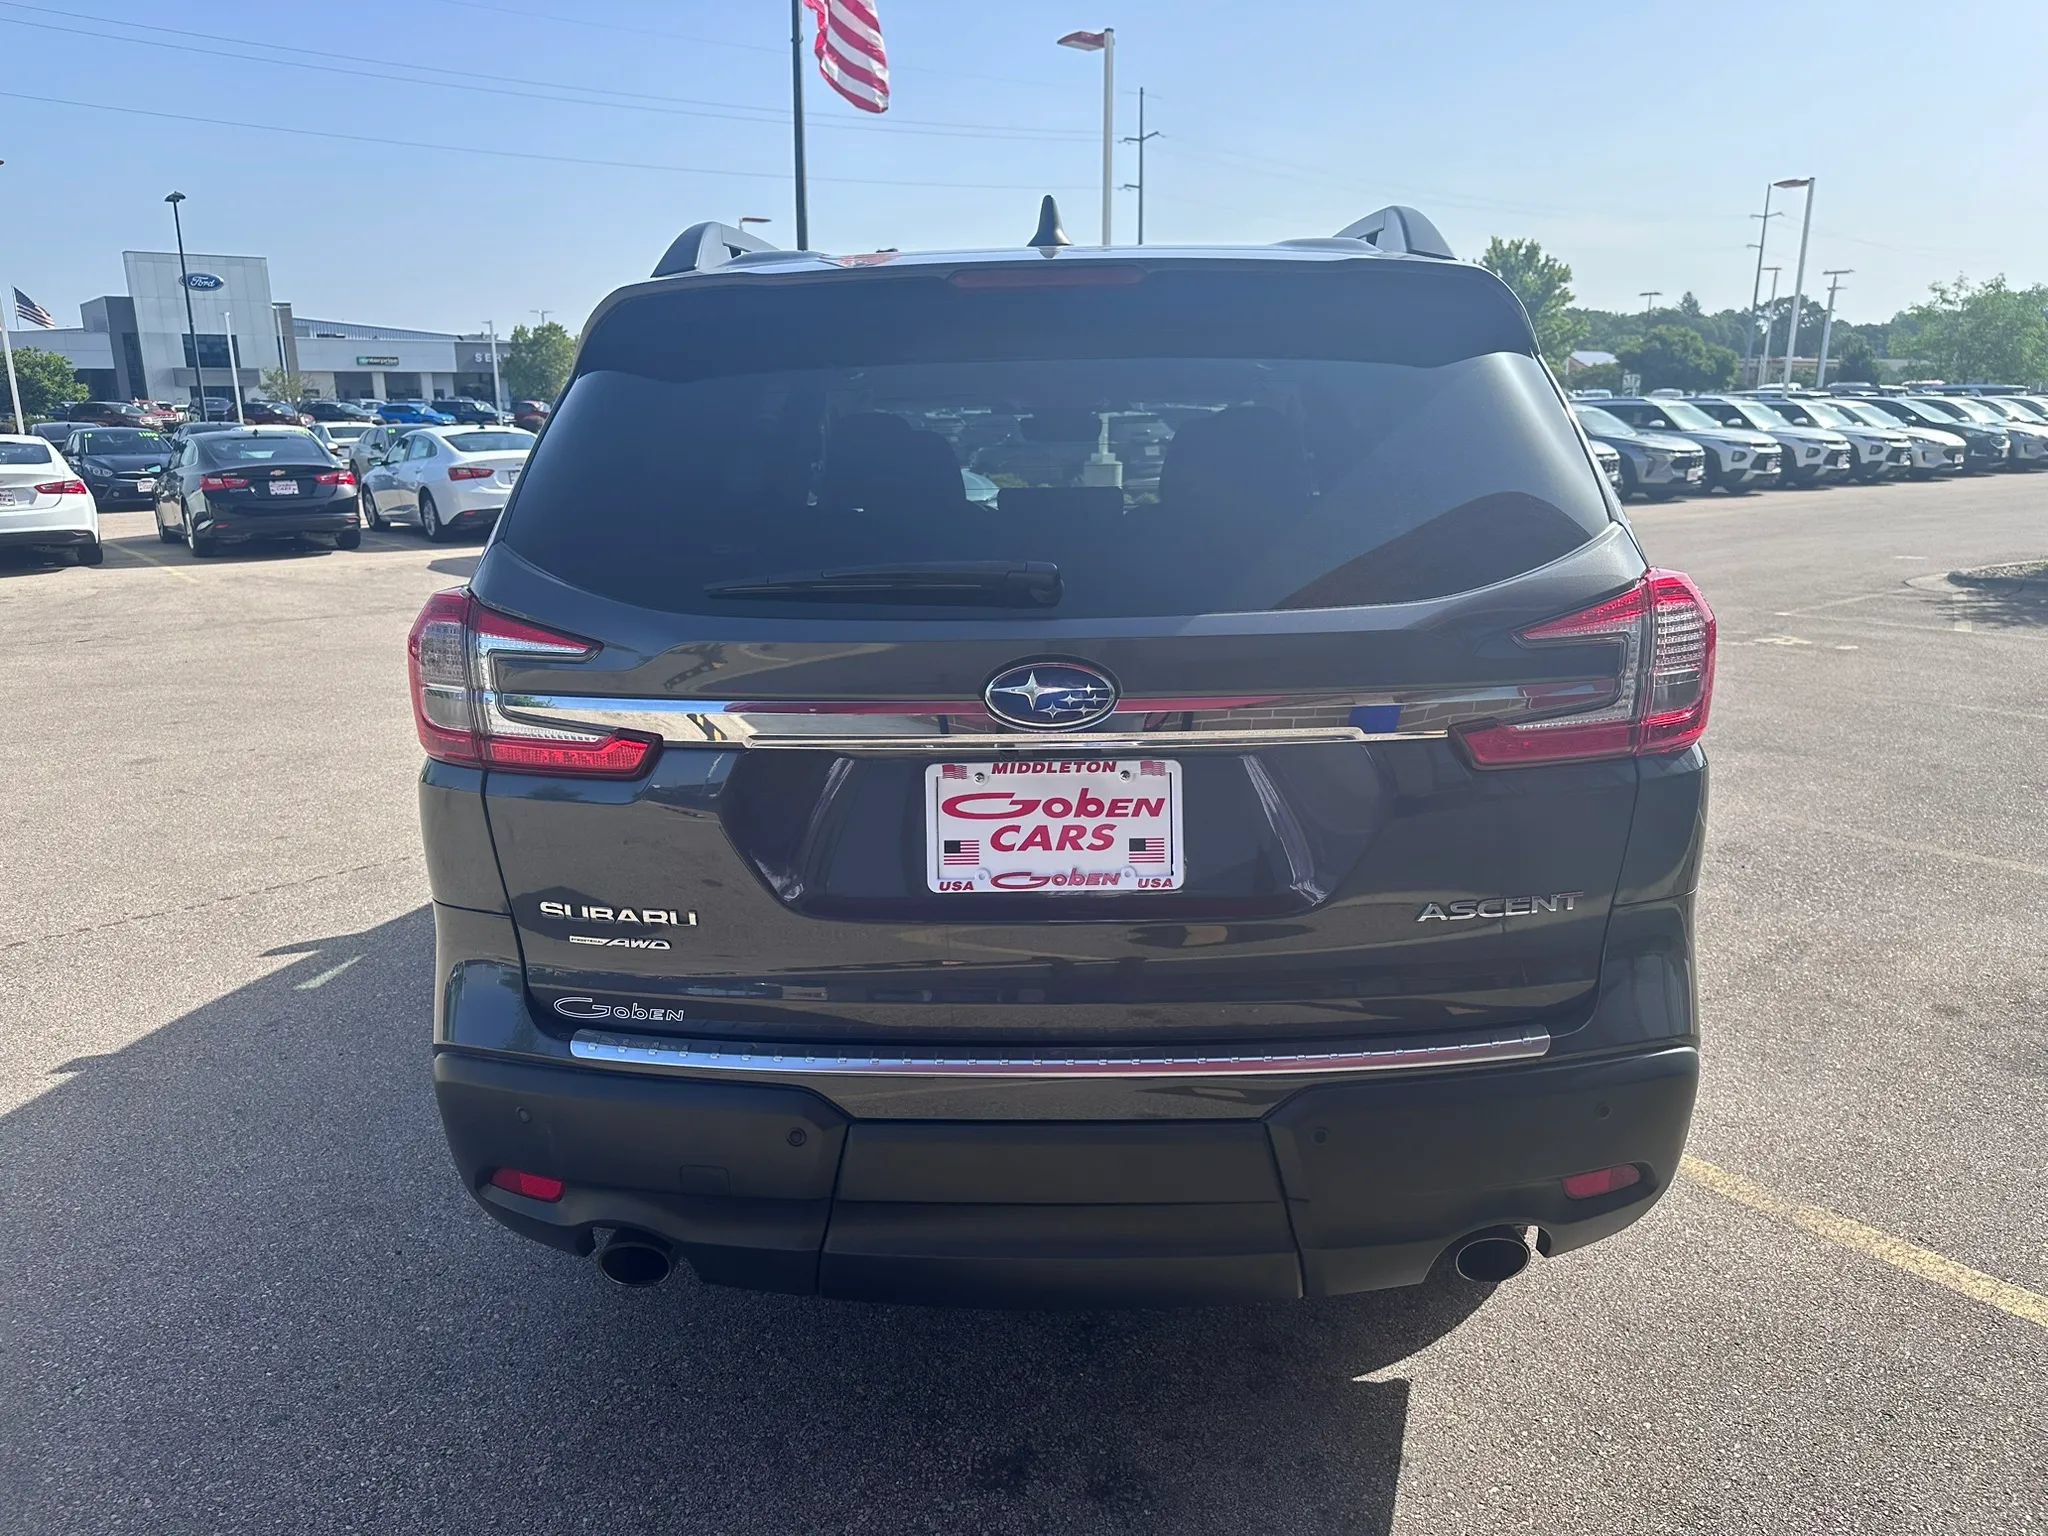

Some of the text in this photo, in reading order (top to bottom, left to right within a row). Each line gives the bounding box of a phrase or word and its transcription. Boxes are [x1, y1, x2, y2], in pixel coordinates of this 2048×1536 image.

[190, 276, 216, 287] Ford
[991, 761, 1116, 774] MIDDLETON
[990, 823, 1117, 852] CARS
[939, 881, 974, 891] USA
[1137, 878, 1173, 888] USA
[1417, 891, 1585, 922] ASCENT
[539, 901, 698, 927] SUBARU
[606, 938, 671, 950] AWD
